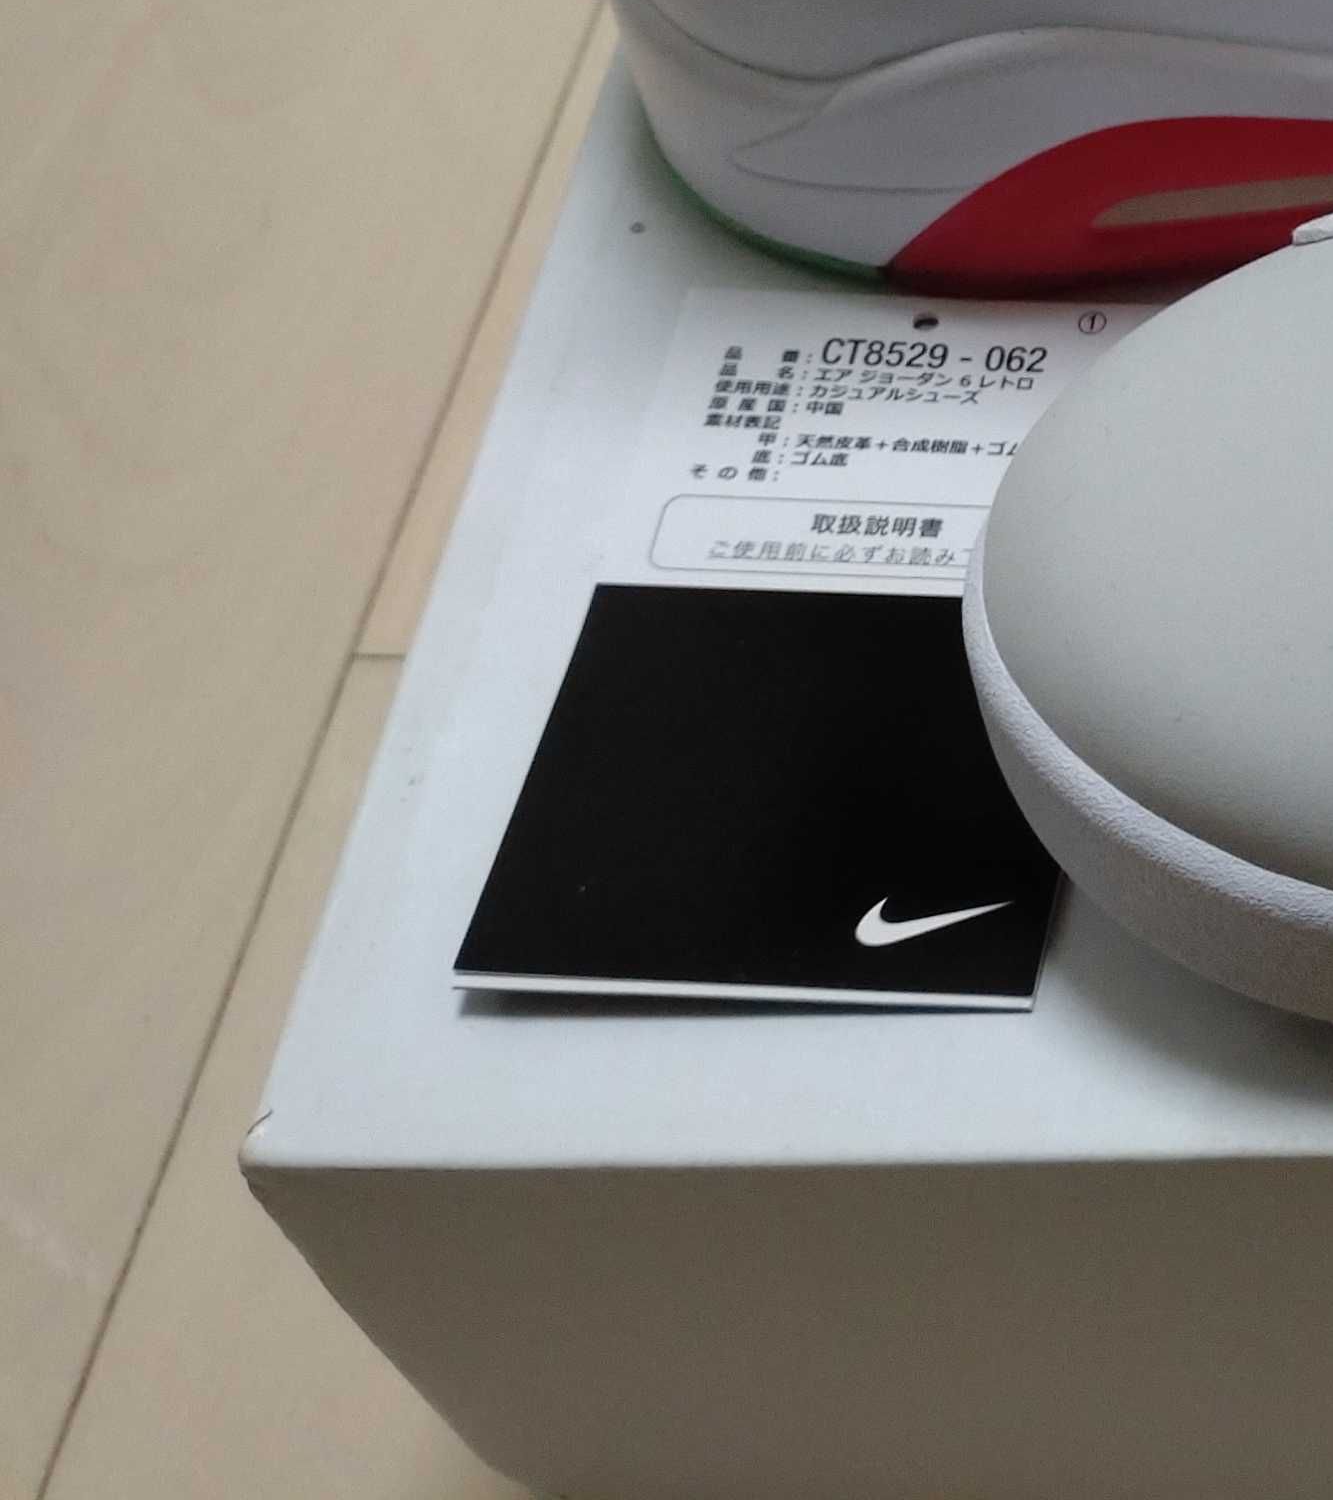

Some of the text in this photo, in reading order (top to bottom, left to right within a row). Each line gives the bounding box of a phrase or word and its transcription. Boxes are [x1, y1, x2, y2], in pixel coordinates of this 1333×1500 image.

[822, 337, 949, 369] CT8529
[985, 345, 1048, 373] 062
[811, 513, 943, 538] 取扱説明書
